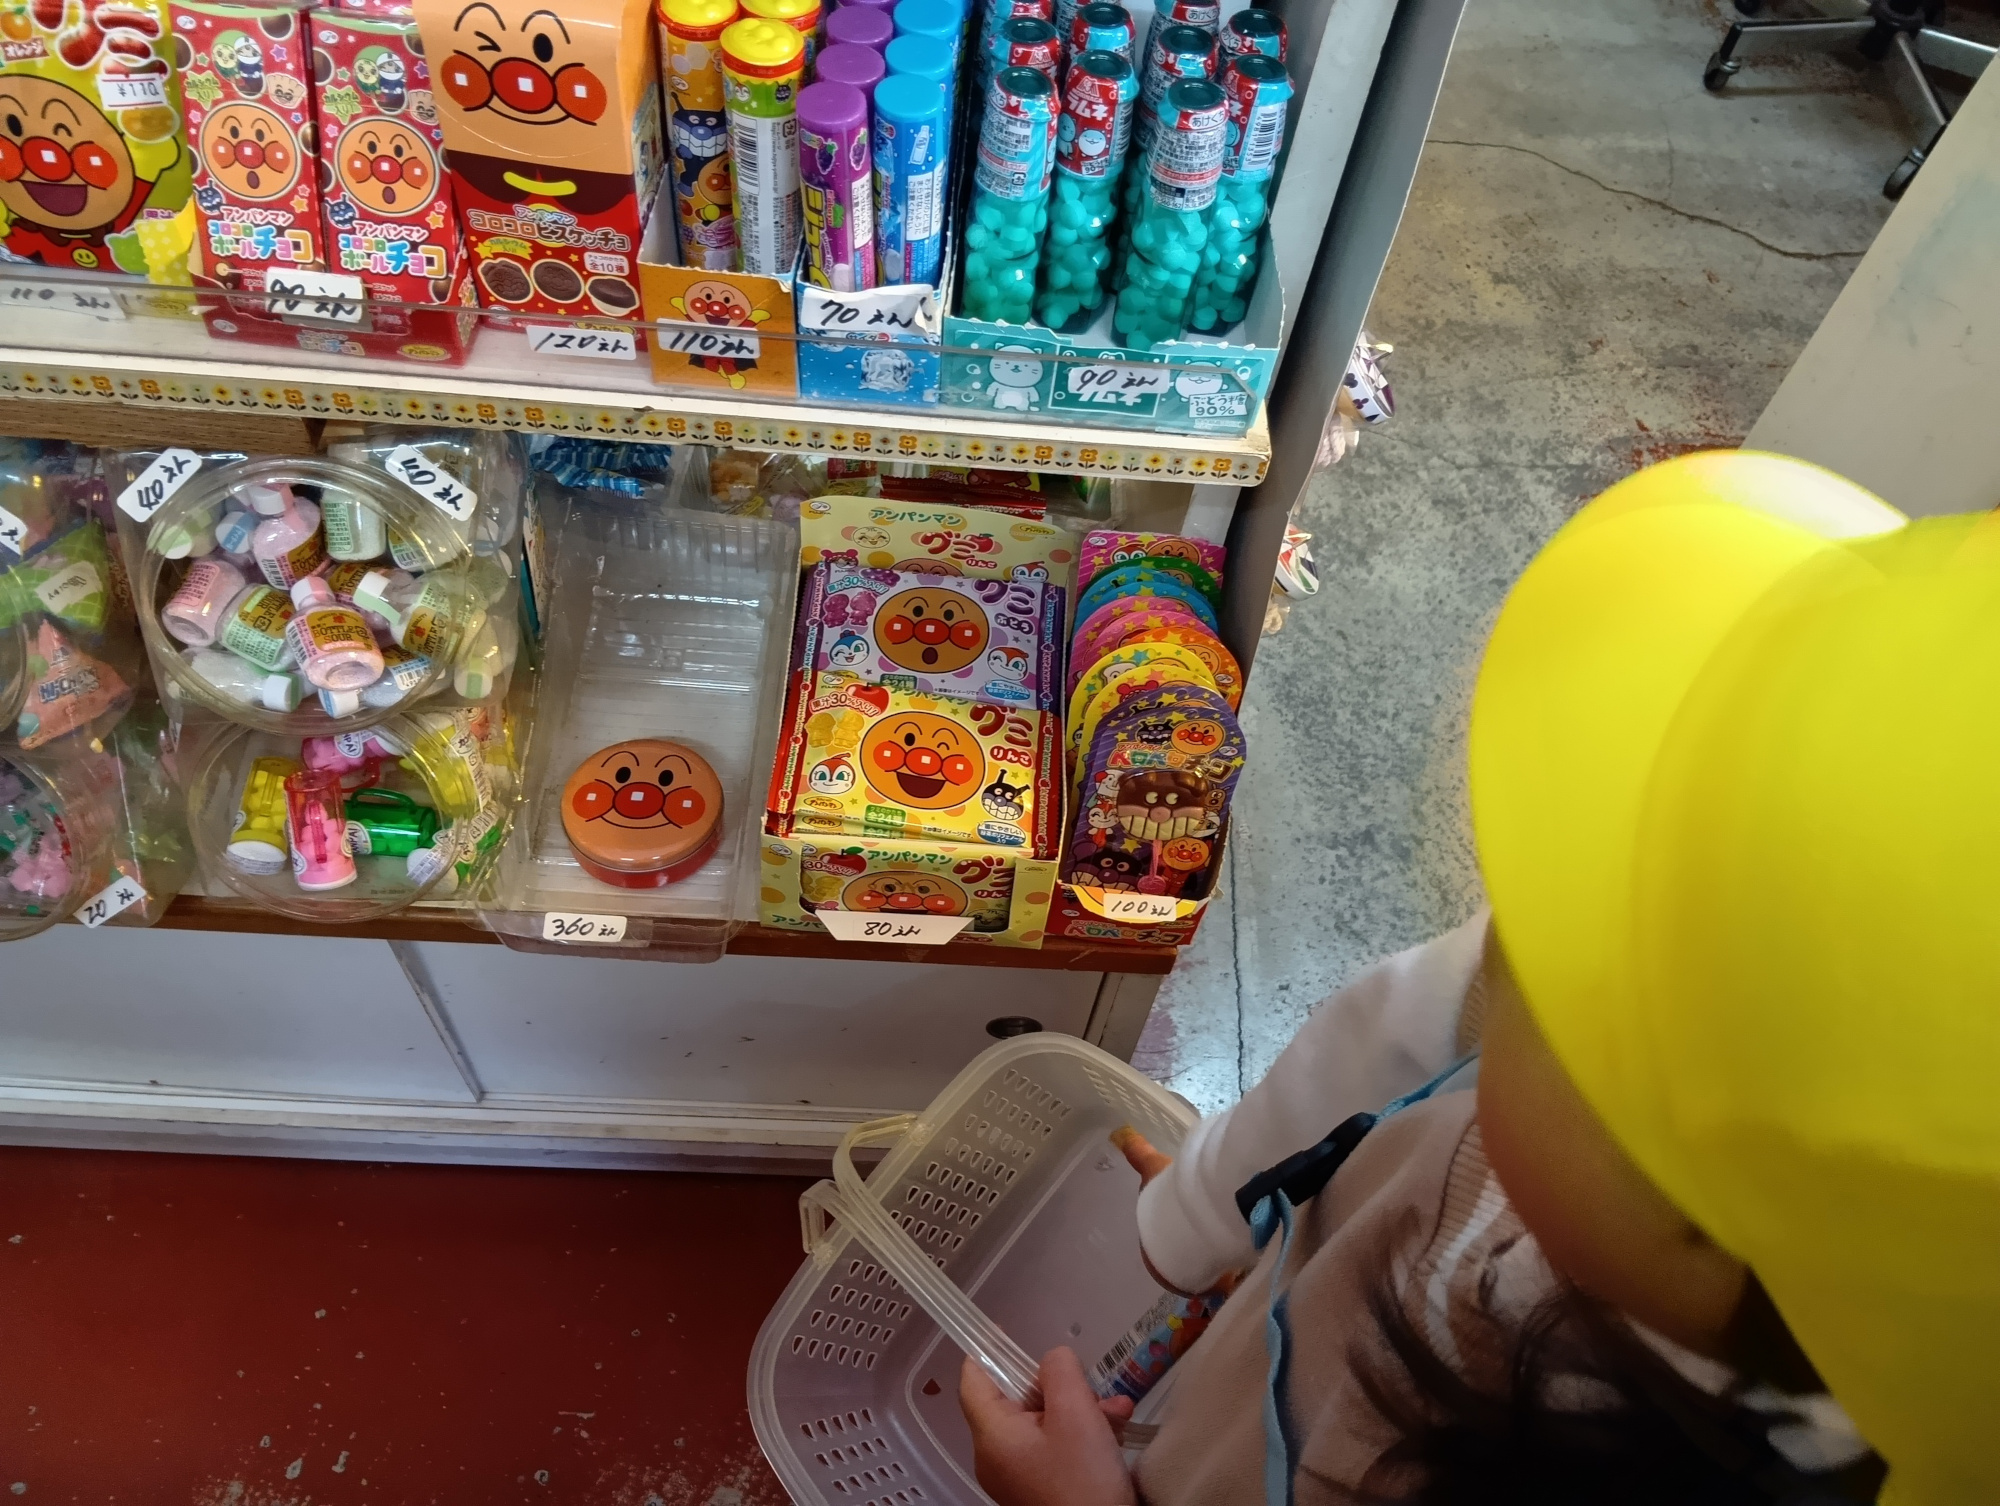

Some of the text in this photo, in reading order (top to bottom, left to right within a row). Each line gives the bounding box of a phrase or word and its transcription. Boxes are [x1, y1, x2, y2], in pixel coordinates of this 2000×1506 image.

[6, 43, 43, 57] オレンジ
[1067, 92, 1109, 121] ラムネ
[1191, 110, 1224, 127] あけくち
[221, 206, 294, 225] アンパンマン
[513, 204, 577, 225] アンパンマン
[208, 220, 254, 237] コロコロ
[353, 220, 429, 241] アンパンマン
[210, 225, 314, 263] ボールチョコ
[338, 234, 387, 253] コロコロ
[340, 241, 447, 279] ボールチョコ
[589, 261, 625, 274] 全10種
[1190, 395, 1246, 407] ぶどう糖
[1195, 405, 1235, 416] 90%
[869, 508, 961, 525] アンパンマン
[919, 530, 979, 560] グミ
[965, 557, 999, 570] りんご
[973, 578, 1037, 617] グミ
[313, 625, 356, 639] BOTTLE
[995, 613, 1035, 635] ぶどう
[324, 633, 354, 643] SOUR
[804, 626, 816, 668] ANPANMAN
[969, 703, 1034, 748] グミ
[785, 743, 798, 790] ANPANMAN
[991, 747, 1032, 767] りんご
[867, 850, 953, 865] アンパンマン
[1065, 925, 1184, 945] ペロペロチョコ
